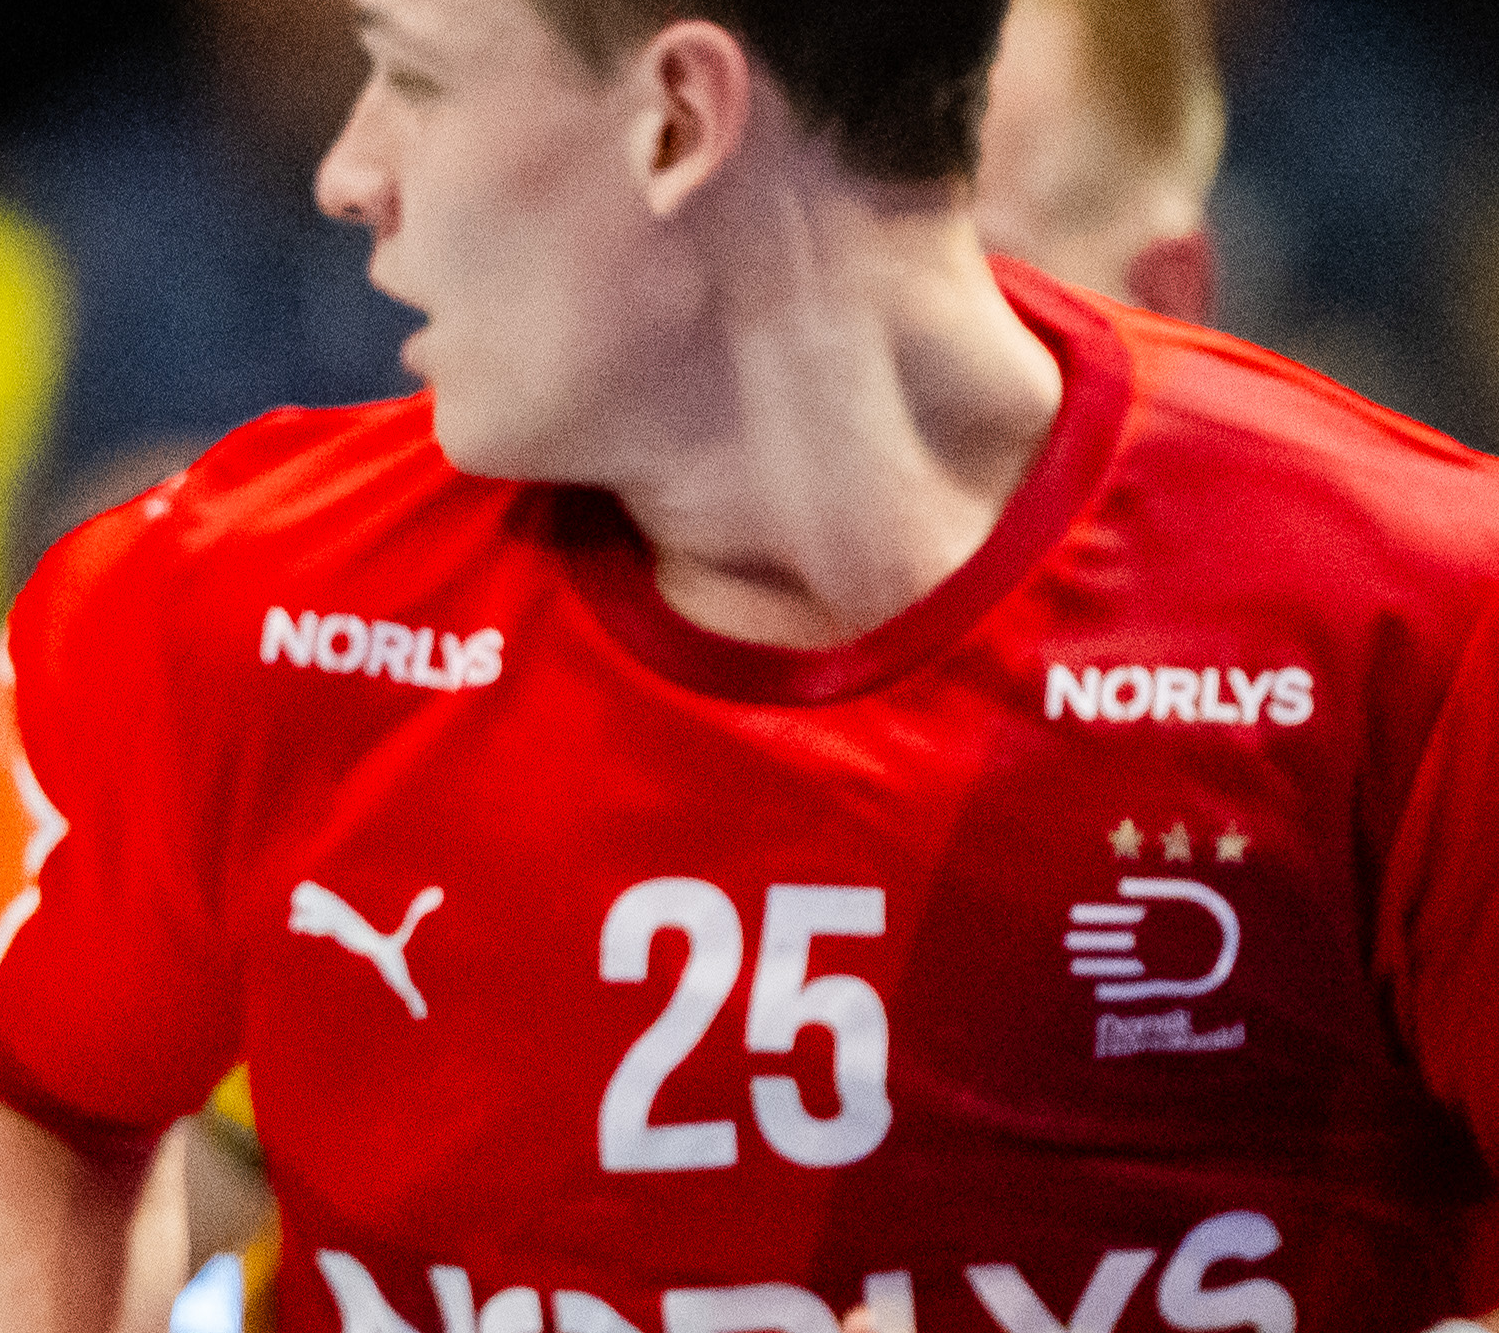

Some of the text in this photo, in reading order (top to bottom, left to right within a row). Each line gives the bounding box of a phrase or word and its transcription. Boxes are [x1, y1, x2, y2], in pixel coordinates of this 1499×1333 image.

[259, 604, 505, 694] NORLYS
[1043, 664, 1314, 726] NORLYS
[597, 874, 893, 1171] 25
